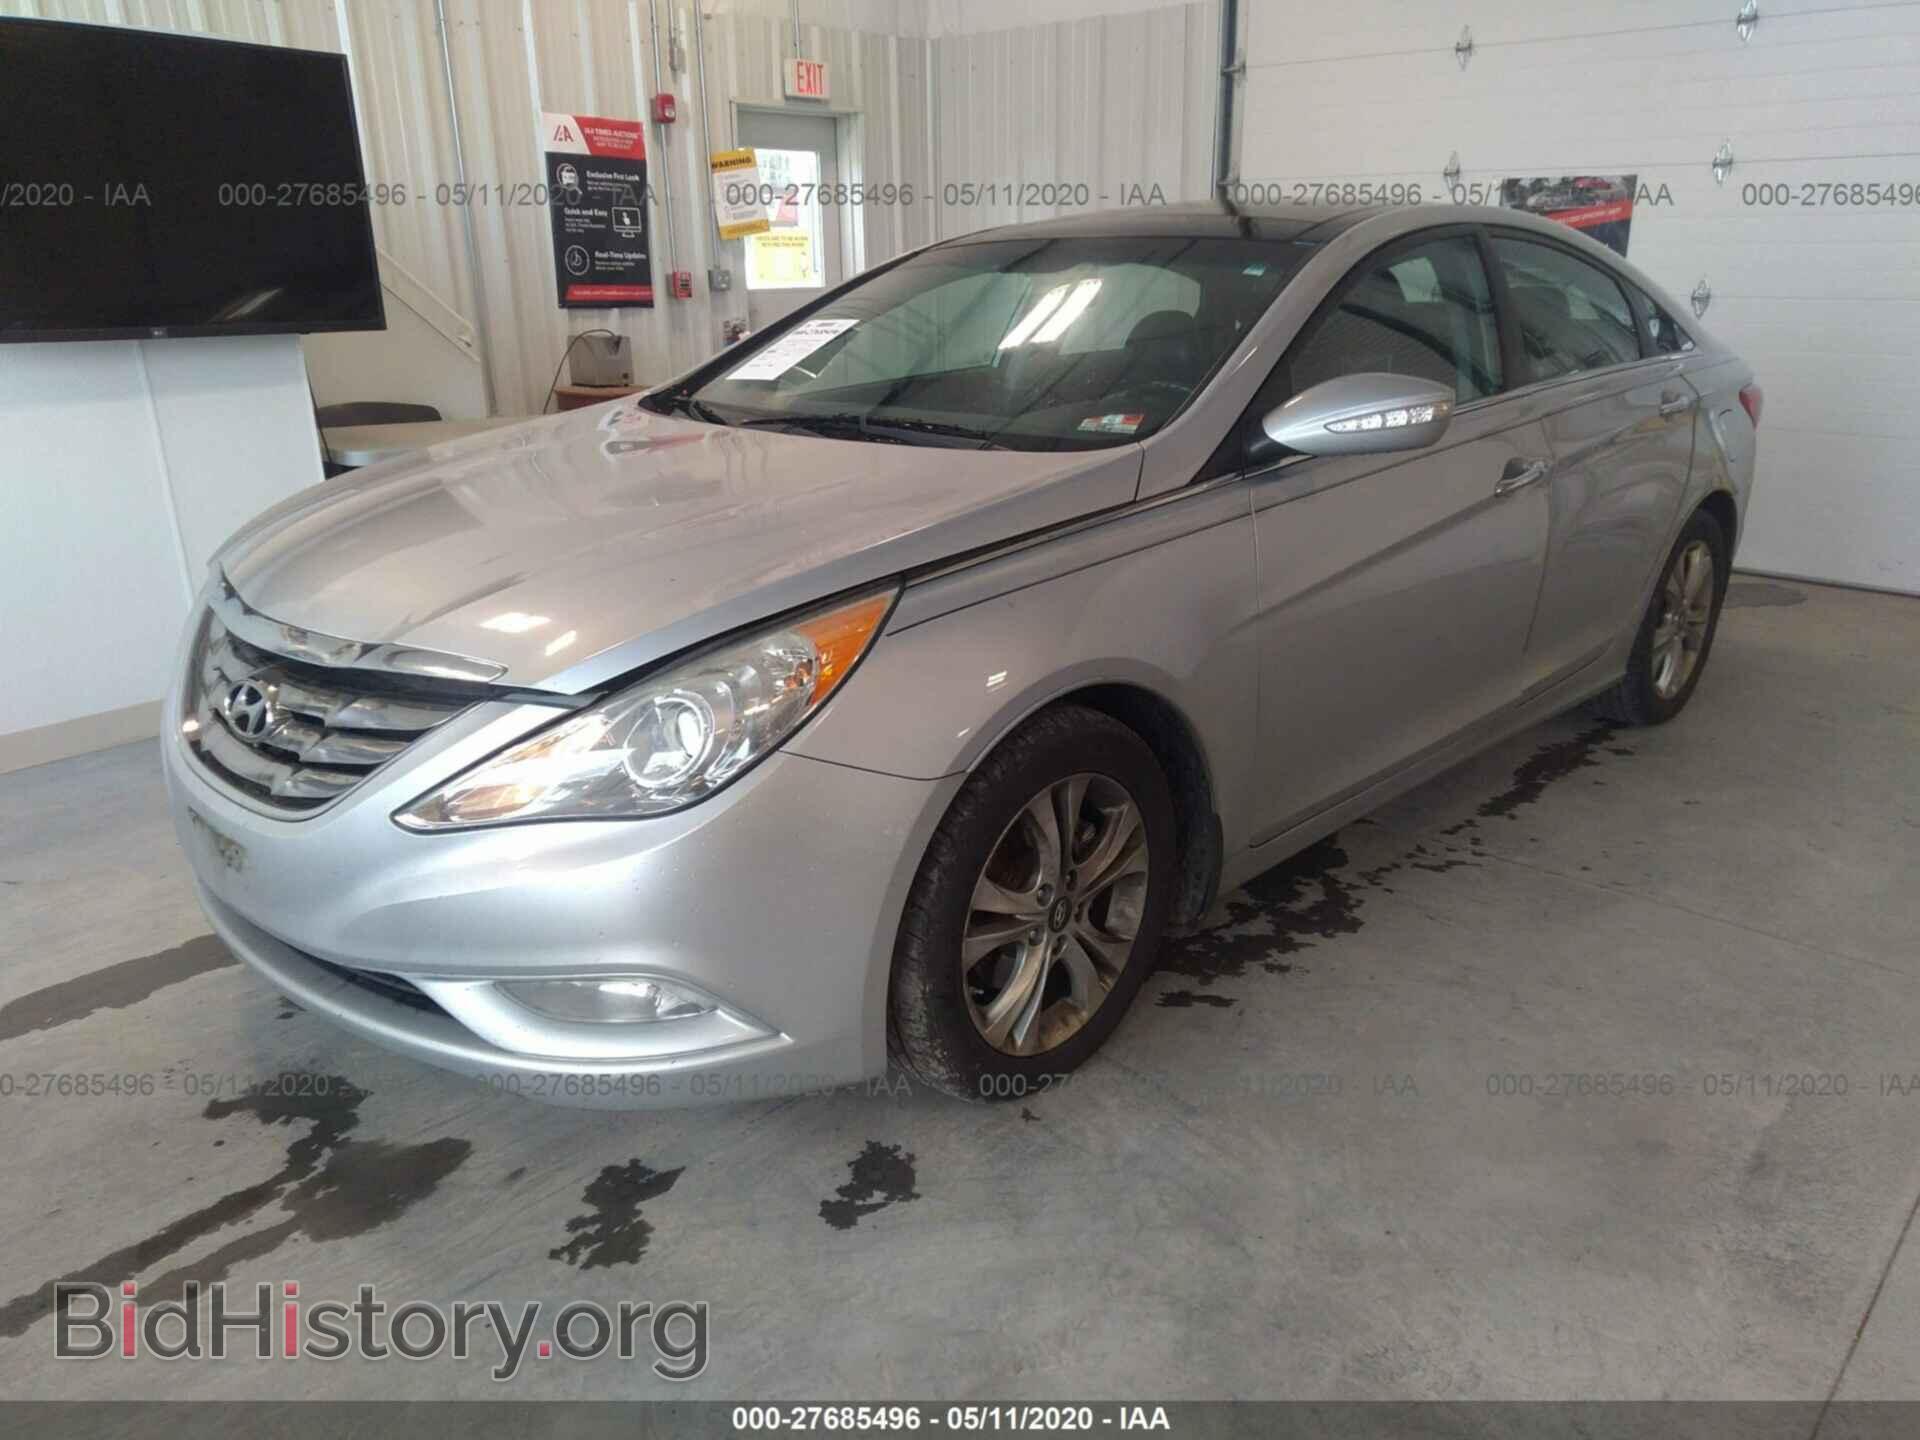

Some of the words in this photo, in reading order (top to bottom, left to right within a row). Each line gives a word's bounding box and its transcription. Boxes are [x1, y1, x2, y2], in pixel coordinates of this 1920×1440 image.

[795, 60, 824, 95] EXIT
[712, 156, 752, 168] WARNING
[582, 208, 593, 216] and
